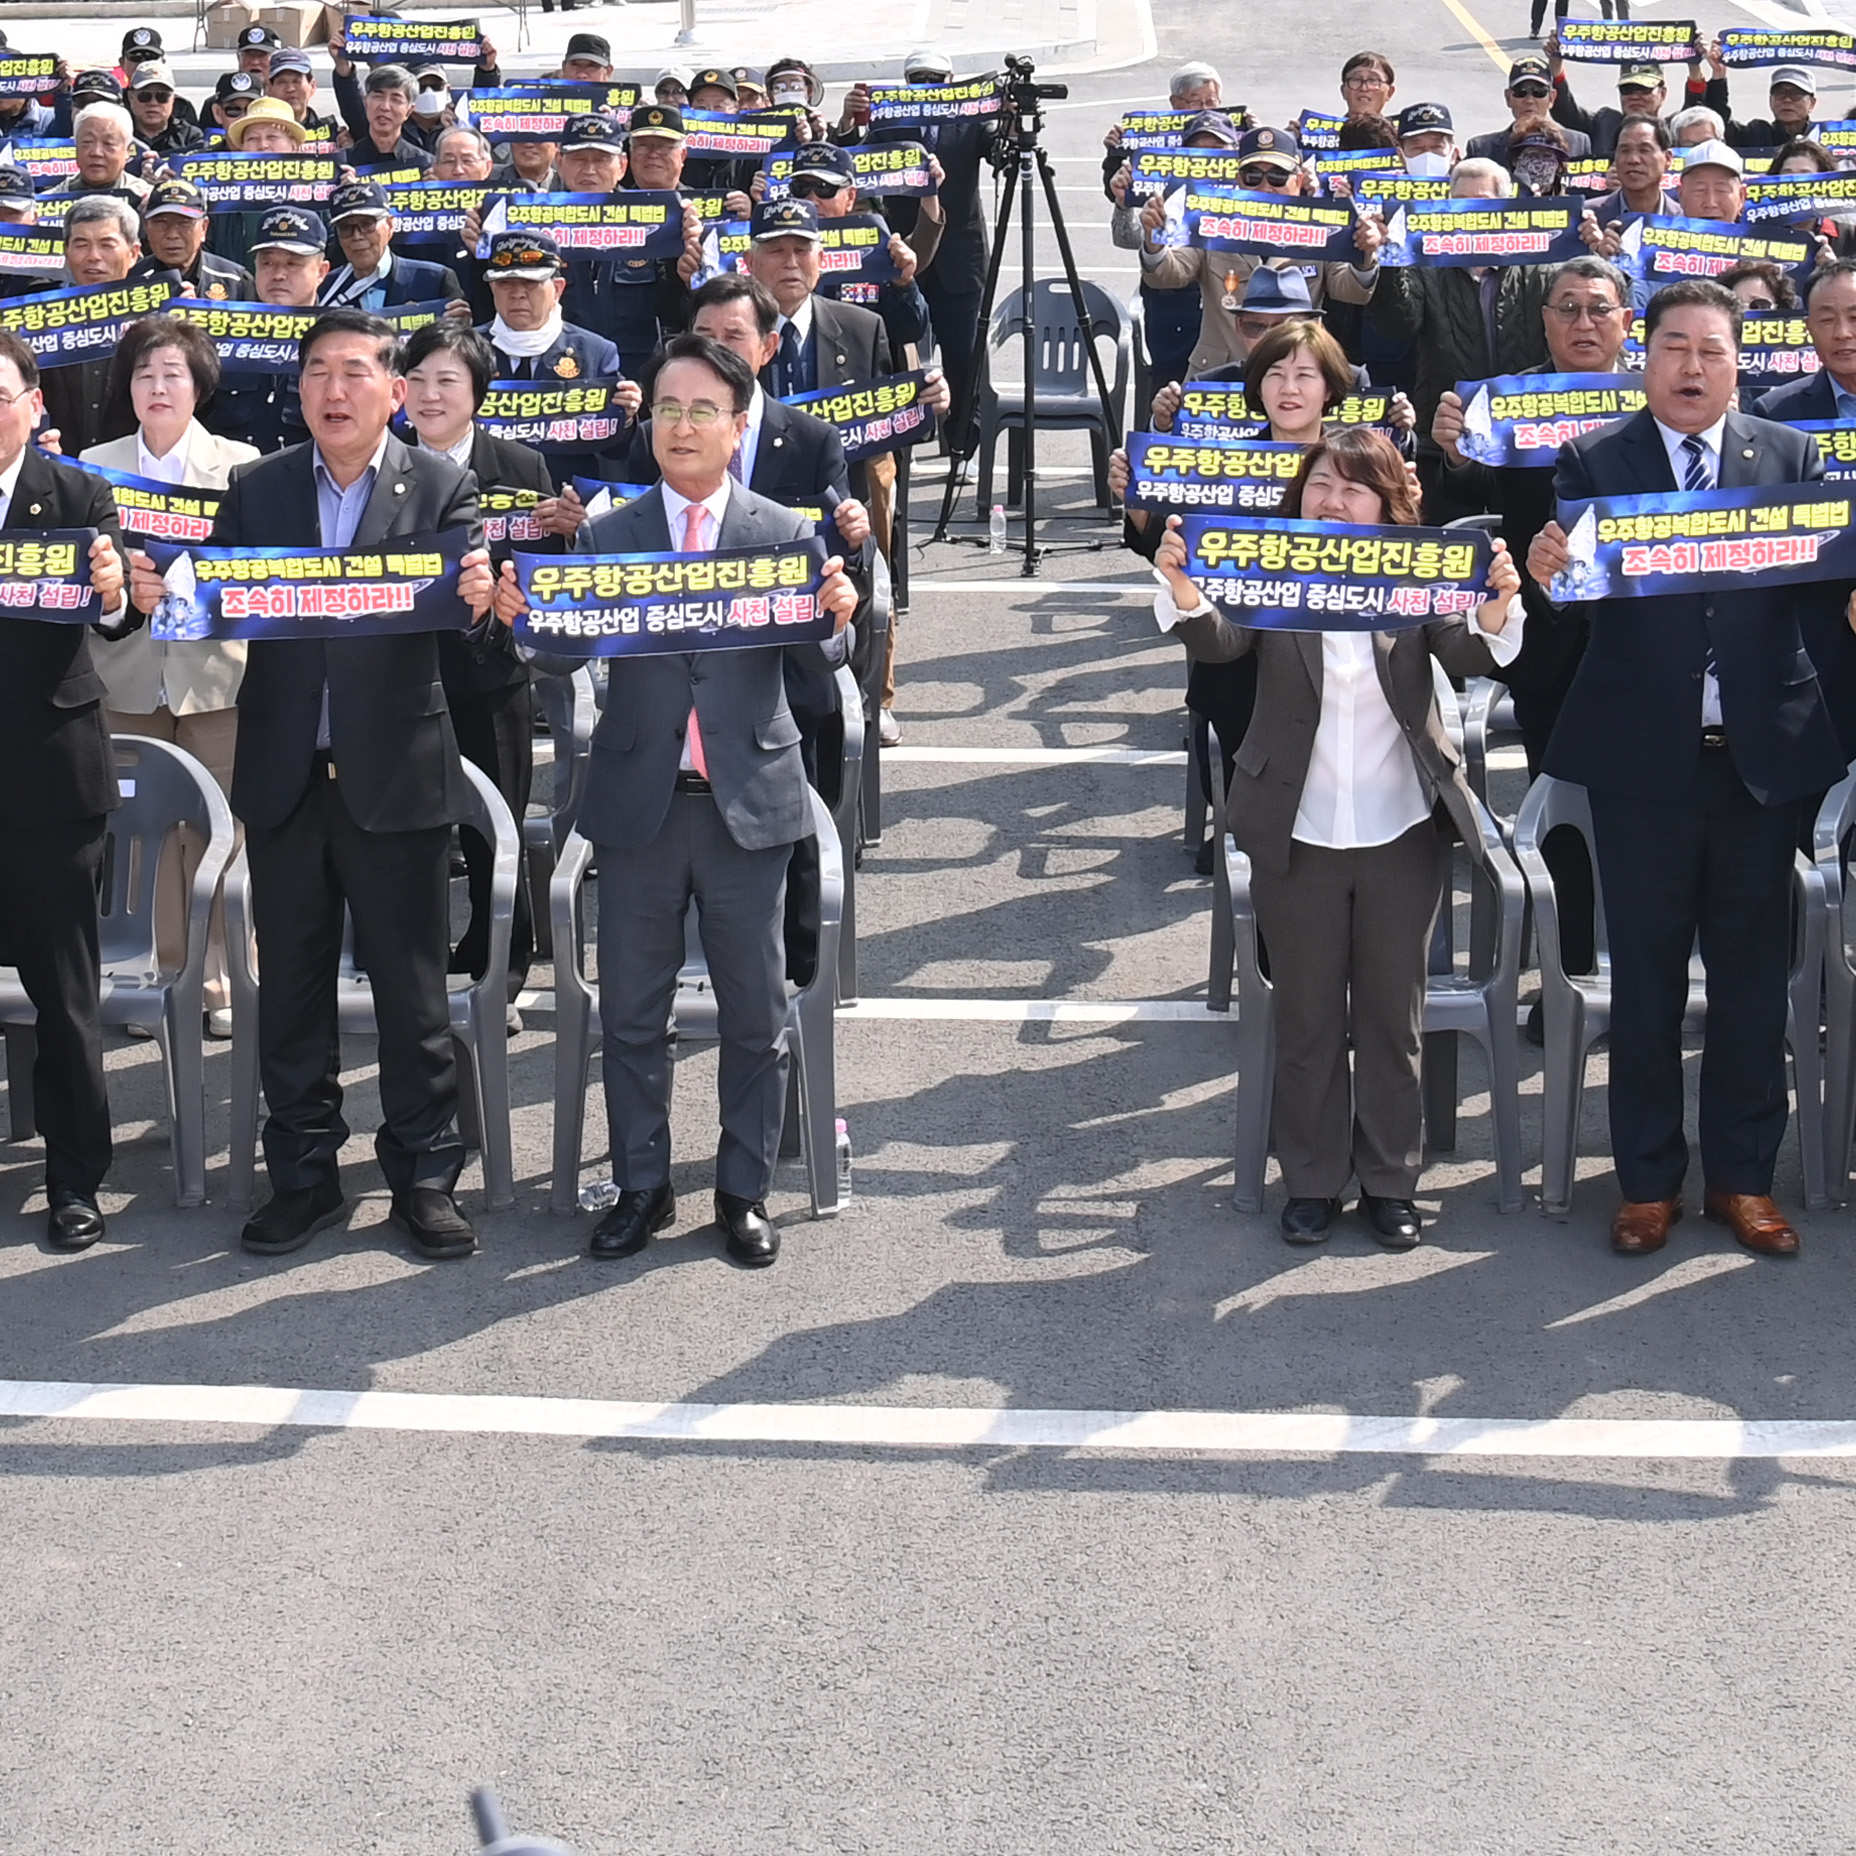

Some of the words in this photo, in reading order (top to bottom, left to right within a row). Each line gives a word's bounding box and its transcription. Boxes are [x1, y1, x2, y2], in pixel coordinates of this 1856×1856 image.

[351, 22, 476, 40] 우주항공산업진흥원
[1565, 25, 1691, 44] 우주항공산업진흥원
[873, 83, 995, 102] 우주항공산업진흥원
[471, 98, 542, 114] 우주항공복합도시
[543, 99, 562, 114] 건설
[922, 103, 959, 118] 중심도시
[479, 115, 518, 133] 조속히
[739, 124, 757, 136] 건설
[183, 160, 335, 181] 우주항공산업진흥원
[243, 185, 287, 201] 중심도시
[508, 205, 601, 224] 우주항공복합도시
[604, 206, 627, 223] 건설
[629, 205, 666, 223] 특별법
[1188, 196, 1284, 219] 우주항공복합도시
[1286, 207, 1311, 222] 건설
[1409, 212, 1503, 232] 우주항공복합도시
[1505, 212, 1530, 230] 건설
[1530, 210, 1569, 229] 특별법
[571, 226, 647, 247] 제정하라!!
[1198, 215, 1251, 241] 조속히
[1249, 218, 1329, 248] 제정하라!!
[1421, 233, 1473, 255] 조속히
[1471, 231, 1552, 256] 제정하라!!
[1644, 230, 1740, 255] 우주항공복합도시
[1743, 242, 1768, 258] 건설
[1767, 242, 1807, 262] 특별법
[1653, 250, 1709, 276] 조속히
[61, 326, 117, 350] 중심도시
[235, 343, 294, 361] 중심도시
[1767, 350, 1800, 373] 사천
[1493, 391, 1618, 420] 우주항공복합도시
[548, 420, 578, 441] 사천
[864, 417, 892, 442] 사천
[1513, 420, 1572, 450] 조속히
[1136, 480, 1234, 506] 우주항공산업
[170, 497, 201, 516] 건설
[1600, 510, 1747, 543] 우주항공복합도시
[1751, 506, 1789, 532] 건설
[1792, 502, 1850, 529] 특별법
[1199, 531, 1474, 579] 우주항공산업진흥원
[1621, 541, 1700, 576] 조속히
[1699, 533, 1821, 573] 제정하라!!
[196, 556, 342, 581] 우주항공복합도시
[347, 555, 383, 578] 건설
[385, 553, 443, 576] 특별법
[533, 556, 808, 600] 우주항공산업진흥원
[41, 584, 93, 608] 설립!
[220, 585, 297, 619] 조속히
[296, 581, 416, 617] 제정하라!!
[1306, 583, 1385, 614] 중심도시
[1385, 587, 1431, 616] 사천
[527, 606, 640, 636] 우주항공산업
[645, 600, 723, 630] 중심도시
[726, 597, 771, 627] 사천
